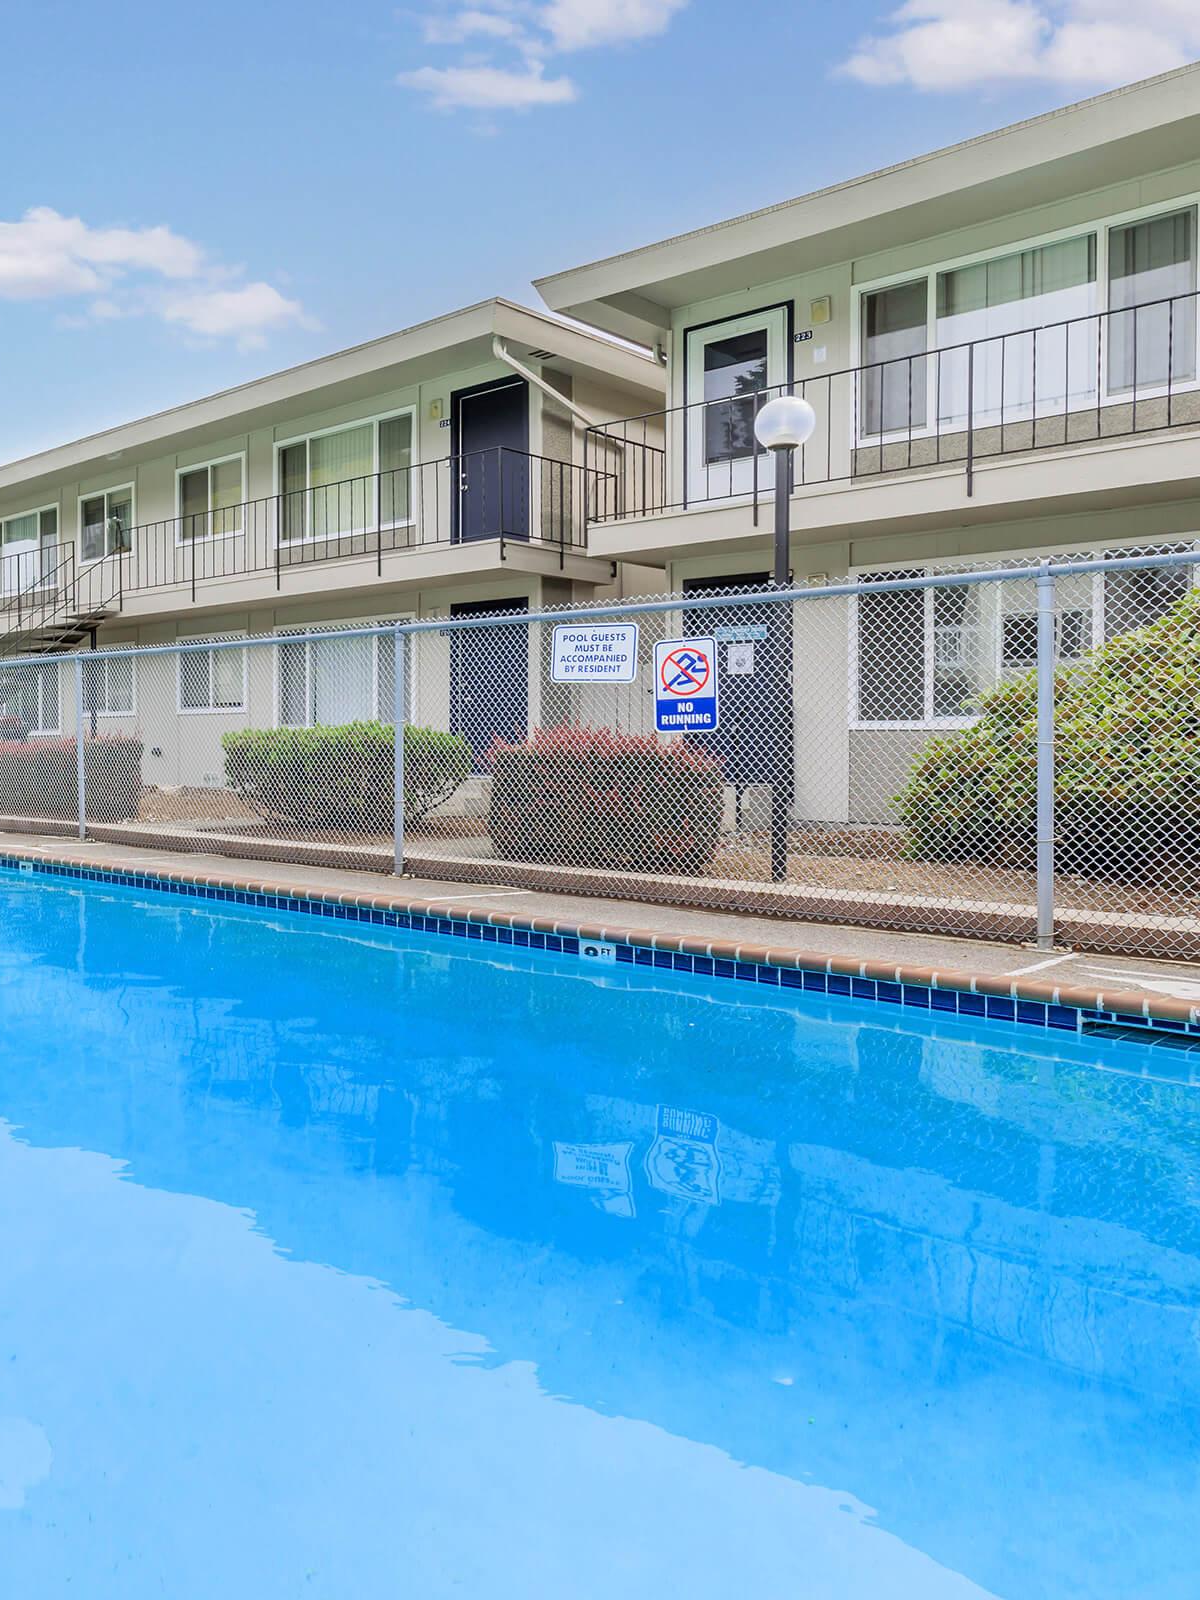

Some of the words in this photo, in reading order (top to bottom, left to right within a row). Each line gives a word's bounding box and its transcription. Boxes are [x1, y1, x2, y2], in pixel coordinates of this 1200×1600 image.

[795, 331, 811, 342] 223
[562, 634, 588, 642] POOL
[591, 633, 626, 642] GUESTS
[574, 644, 600, 652] MUST
[602, 644, 614, 652] BE
[560, 654, 628, 663] ACCOMPANIED
[564, 665, 576, 673] BY
[577, 665, 622, 673] RESIDENT
[677, 702, 694, 713] NO
[661, 713, 712, 725] RUNNING
